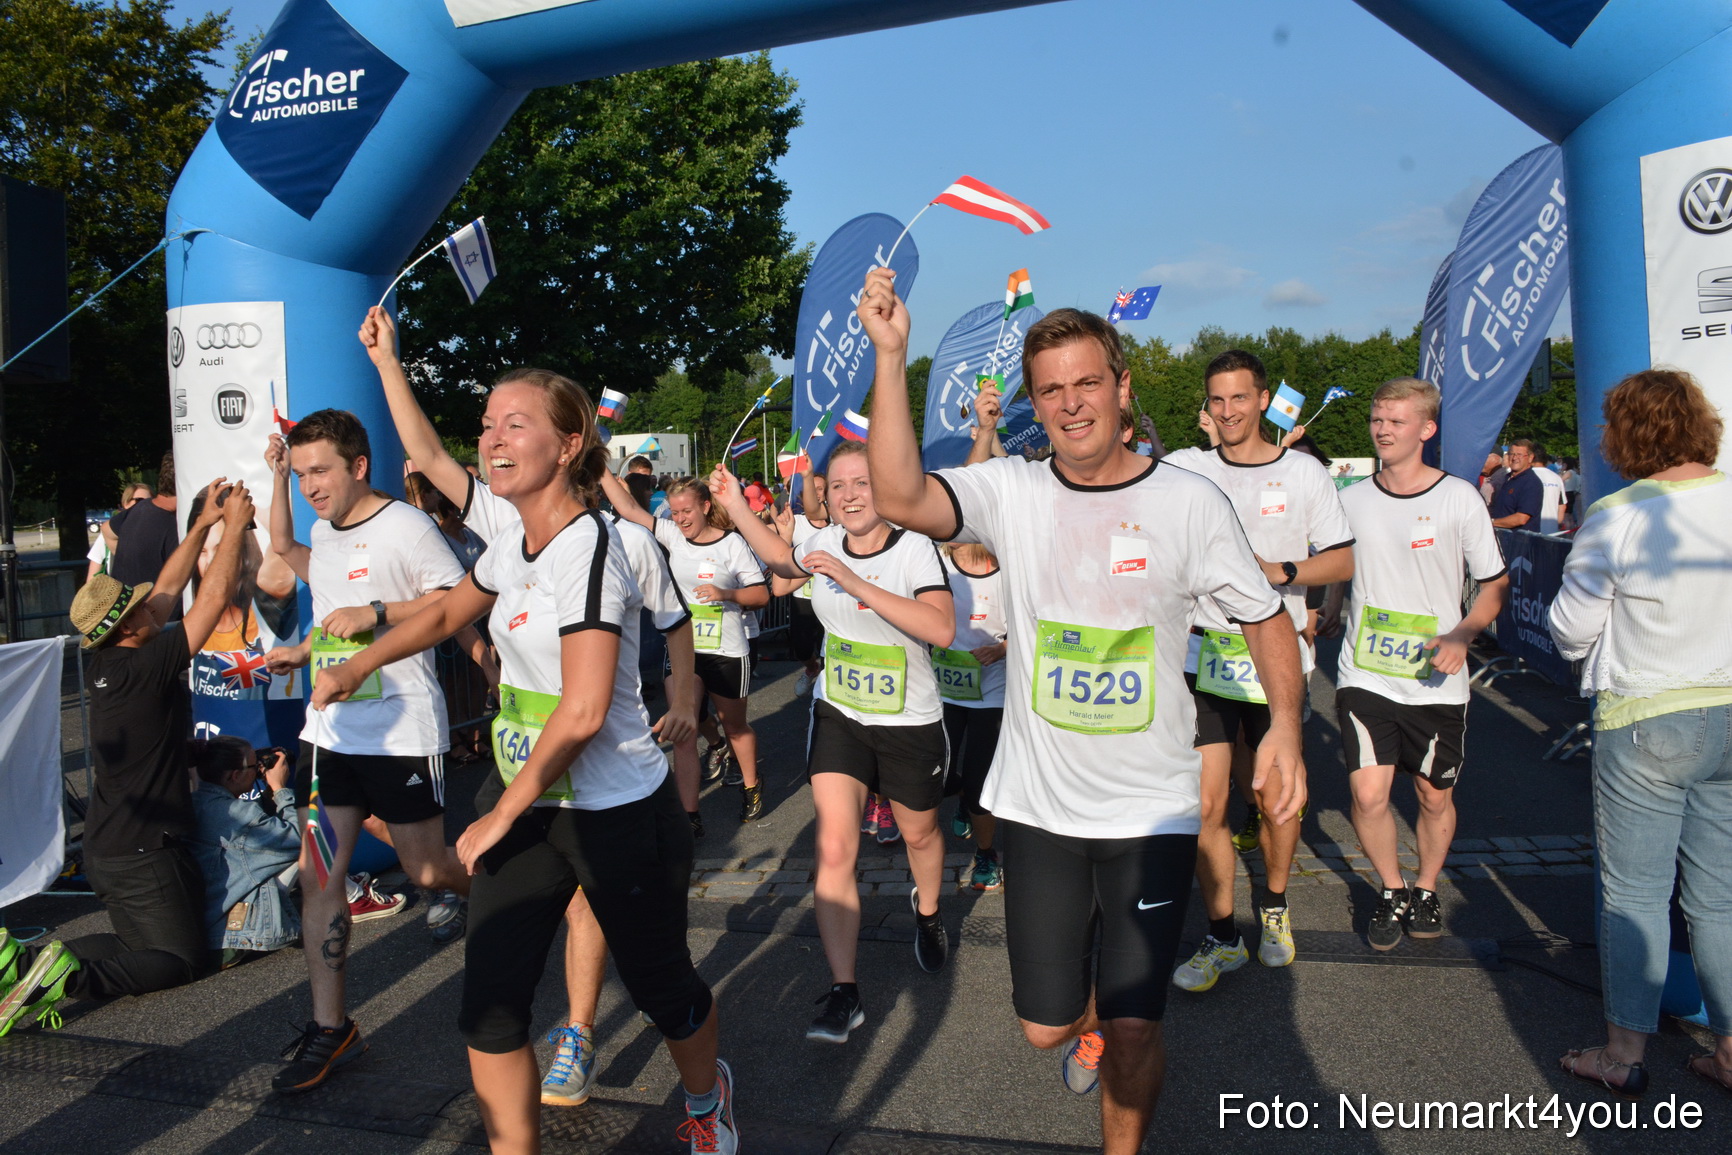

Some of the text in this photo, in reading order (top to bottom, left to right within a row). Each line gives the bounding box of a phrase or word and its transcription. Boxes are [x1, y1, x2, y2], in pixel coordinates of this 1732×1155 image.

[243, 67, 366, 109] Fischer
[250, 97, 358, 123] AUTOMOBILE
[1480, 178, 1566, 352] Fischer
[199, 356, 224, 366] Audi
[220, 397, 244, 417] FIAT
[1511, 586, 1552, 631] Fische
[1366, 633, 1424, 662] 1541
[833, 664, 895, 696] 1513
[934, 666, 974, 688] 1521
[1047, 666, 1142, 705] 1529
[1206, 658, 1261, 684] 152
[1069, 709, 1114, 720] Harald Meier
[497, 728, 531, 765] 154
